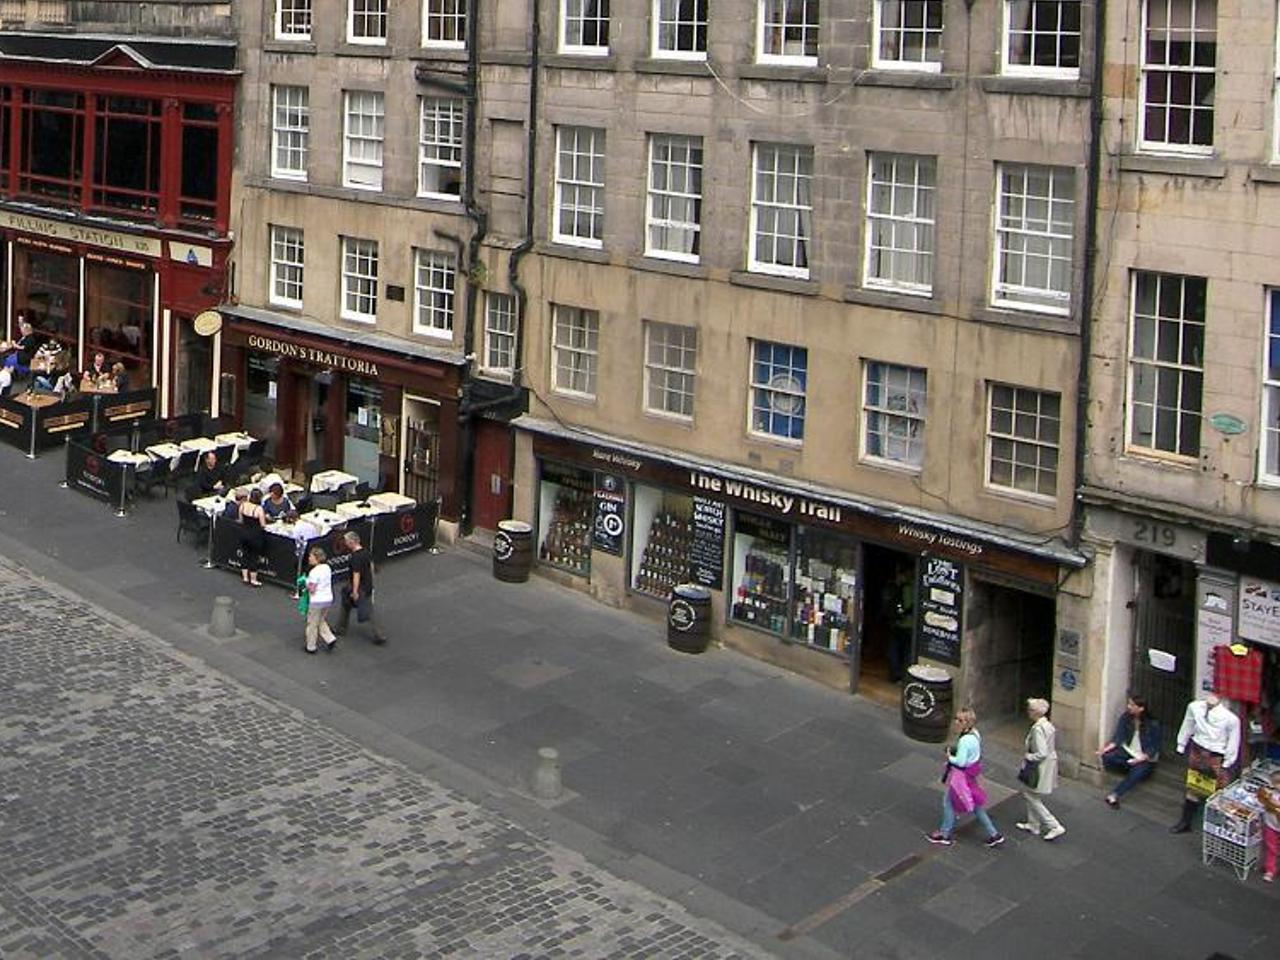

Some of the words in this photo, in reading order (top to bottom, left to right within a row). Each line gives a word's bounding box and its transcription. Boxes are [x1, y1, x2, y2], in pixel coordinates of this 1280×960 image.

[9, 215, 57, 235] FILLING
[69, 226, 124, 247] STATION
[248, 334, 306, 358] GORDON'S
[308, 348, 378, 376] TRATTORIA
[690, 472, 721, 492] The
[725, 480, 795, 514] Whisky
[798, 499, 841, 522] Trail
[898, 523, 937, 544] Whisky
[938, 534, 983, 555] Tastings
[1134, 520, 1176, 547] 219
